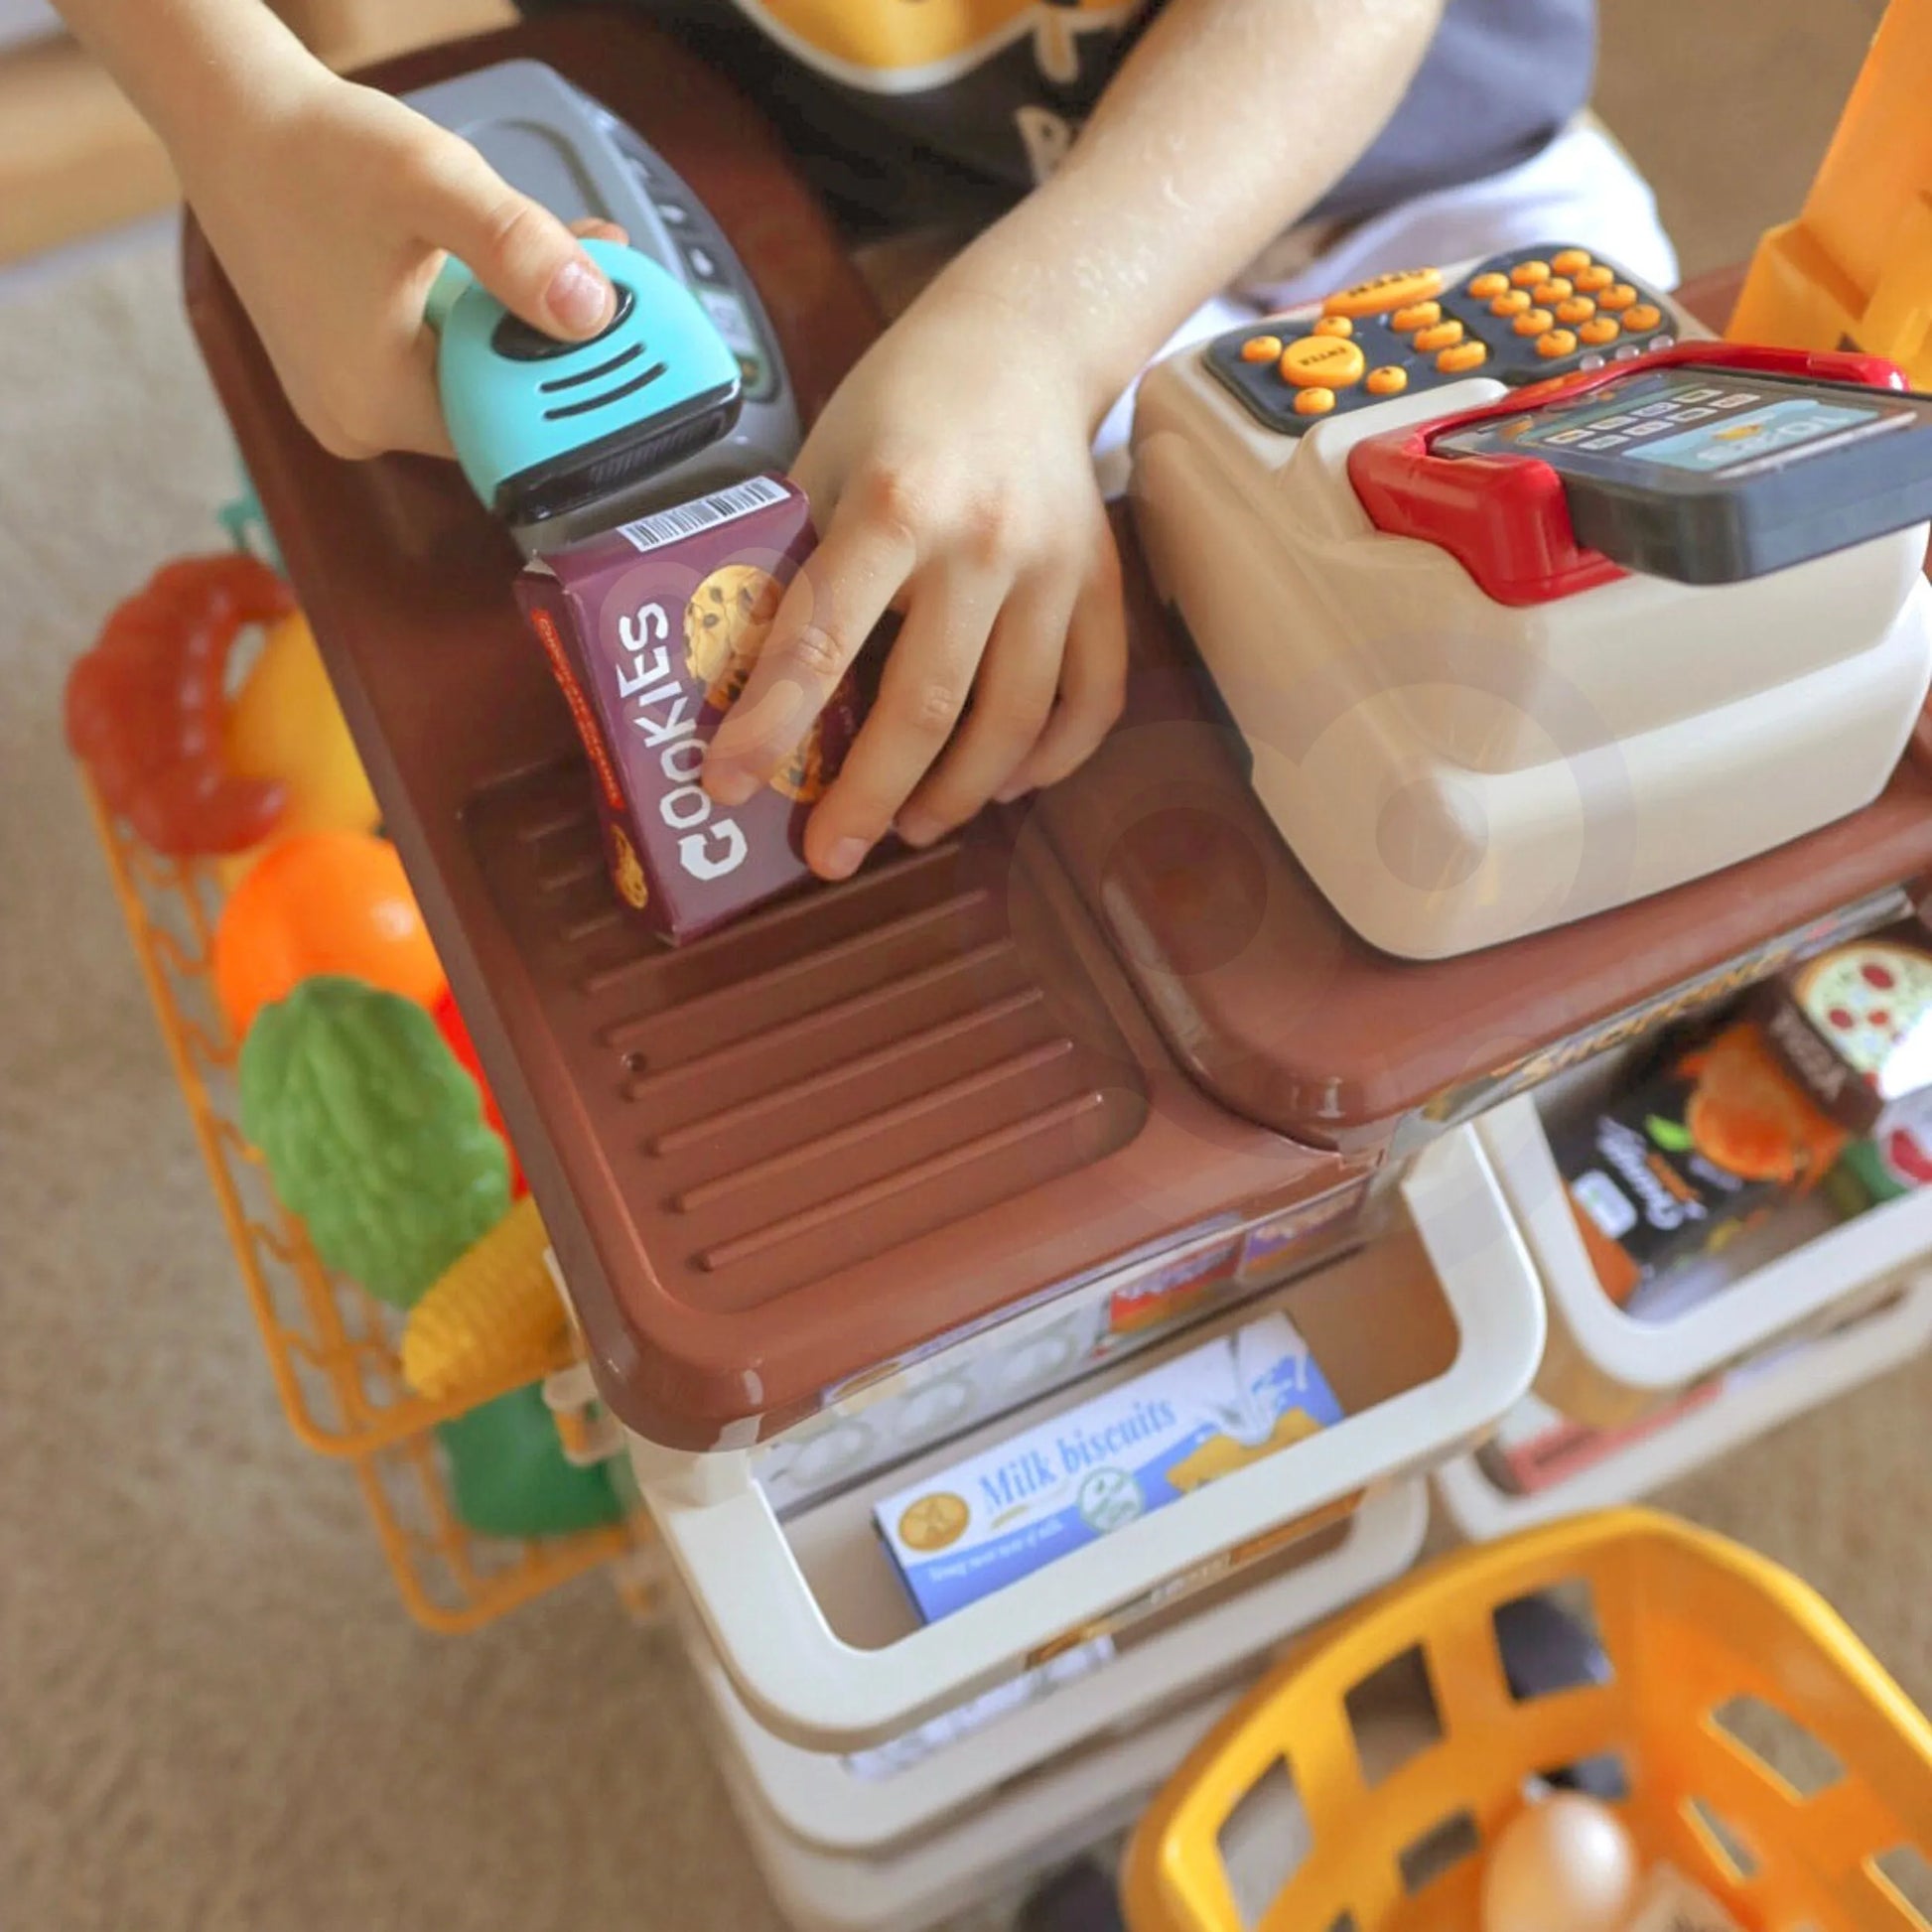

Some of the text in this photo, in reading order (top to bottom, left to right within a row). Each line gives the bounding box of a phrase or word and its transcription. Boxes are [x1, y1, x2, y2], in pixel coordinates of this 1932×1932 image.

[616, 602, 748, 881] COOKIES
[978, 1399, 1177, 1514] Milk biscuits
